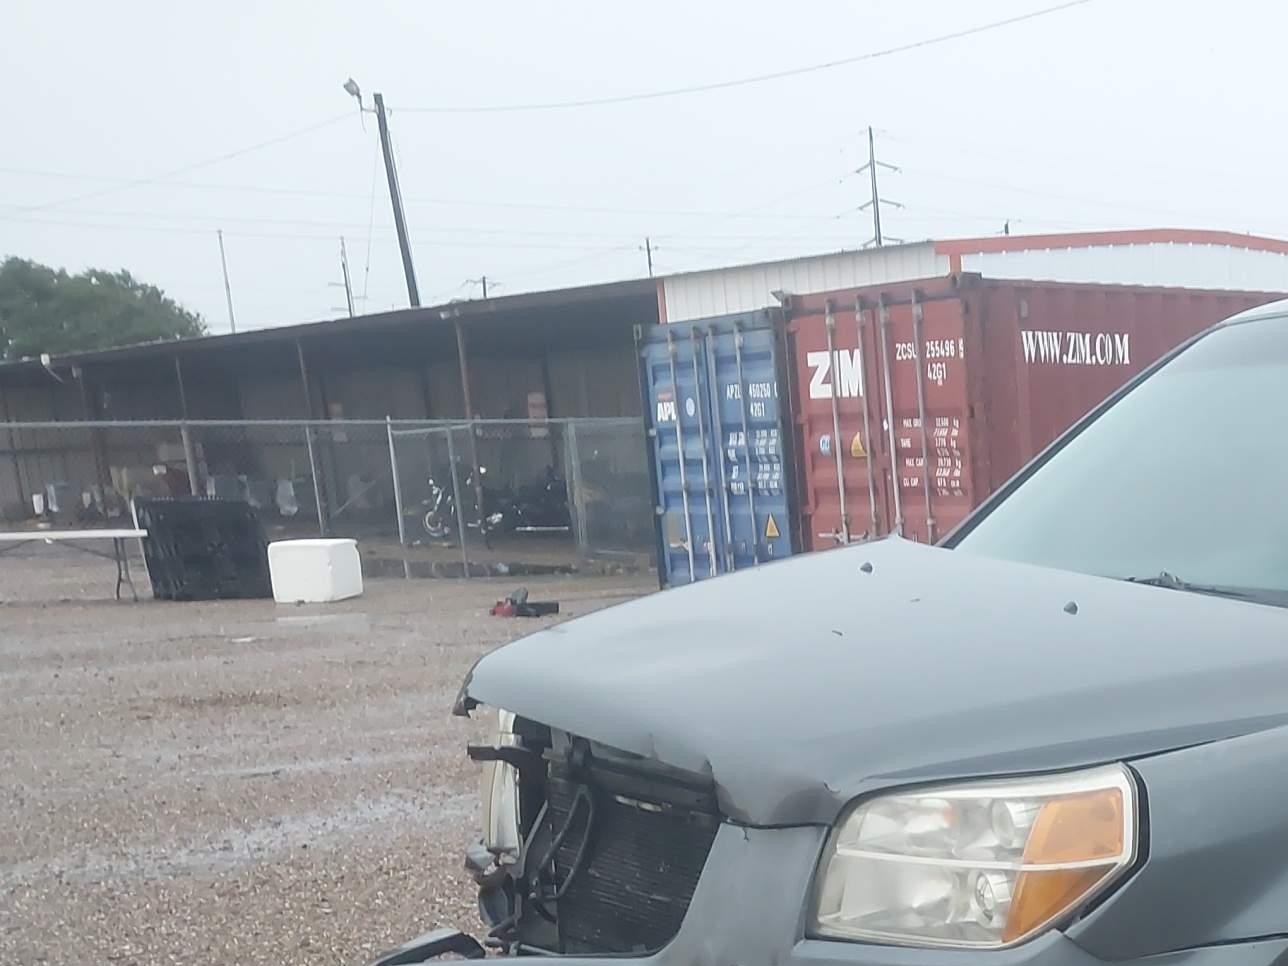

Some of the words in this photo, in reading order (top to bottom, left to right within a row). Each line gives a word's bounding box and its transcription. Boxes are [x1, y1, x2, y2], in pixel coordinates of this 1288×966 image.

[925, 340, 955, 358] 255496
[807, 348, 864, 400] ZIM
[927, 362, 947, 380] 42G1
[657, 401, 677, 422] APL
